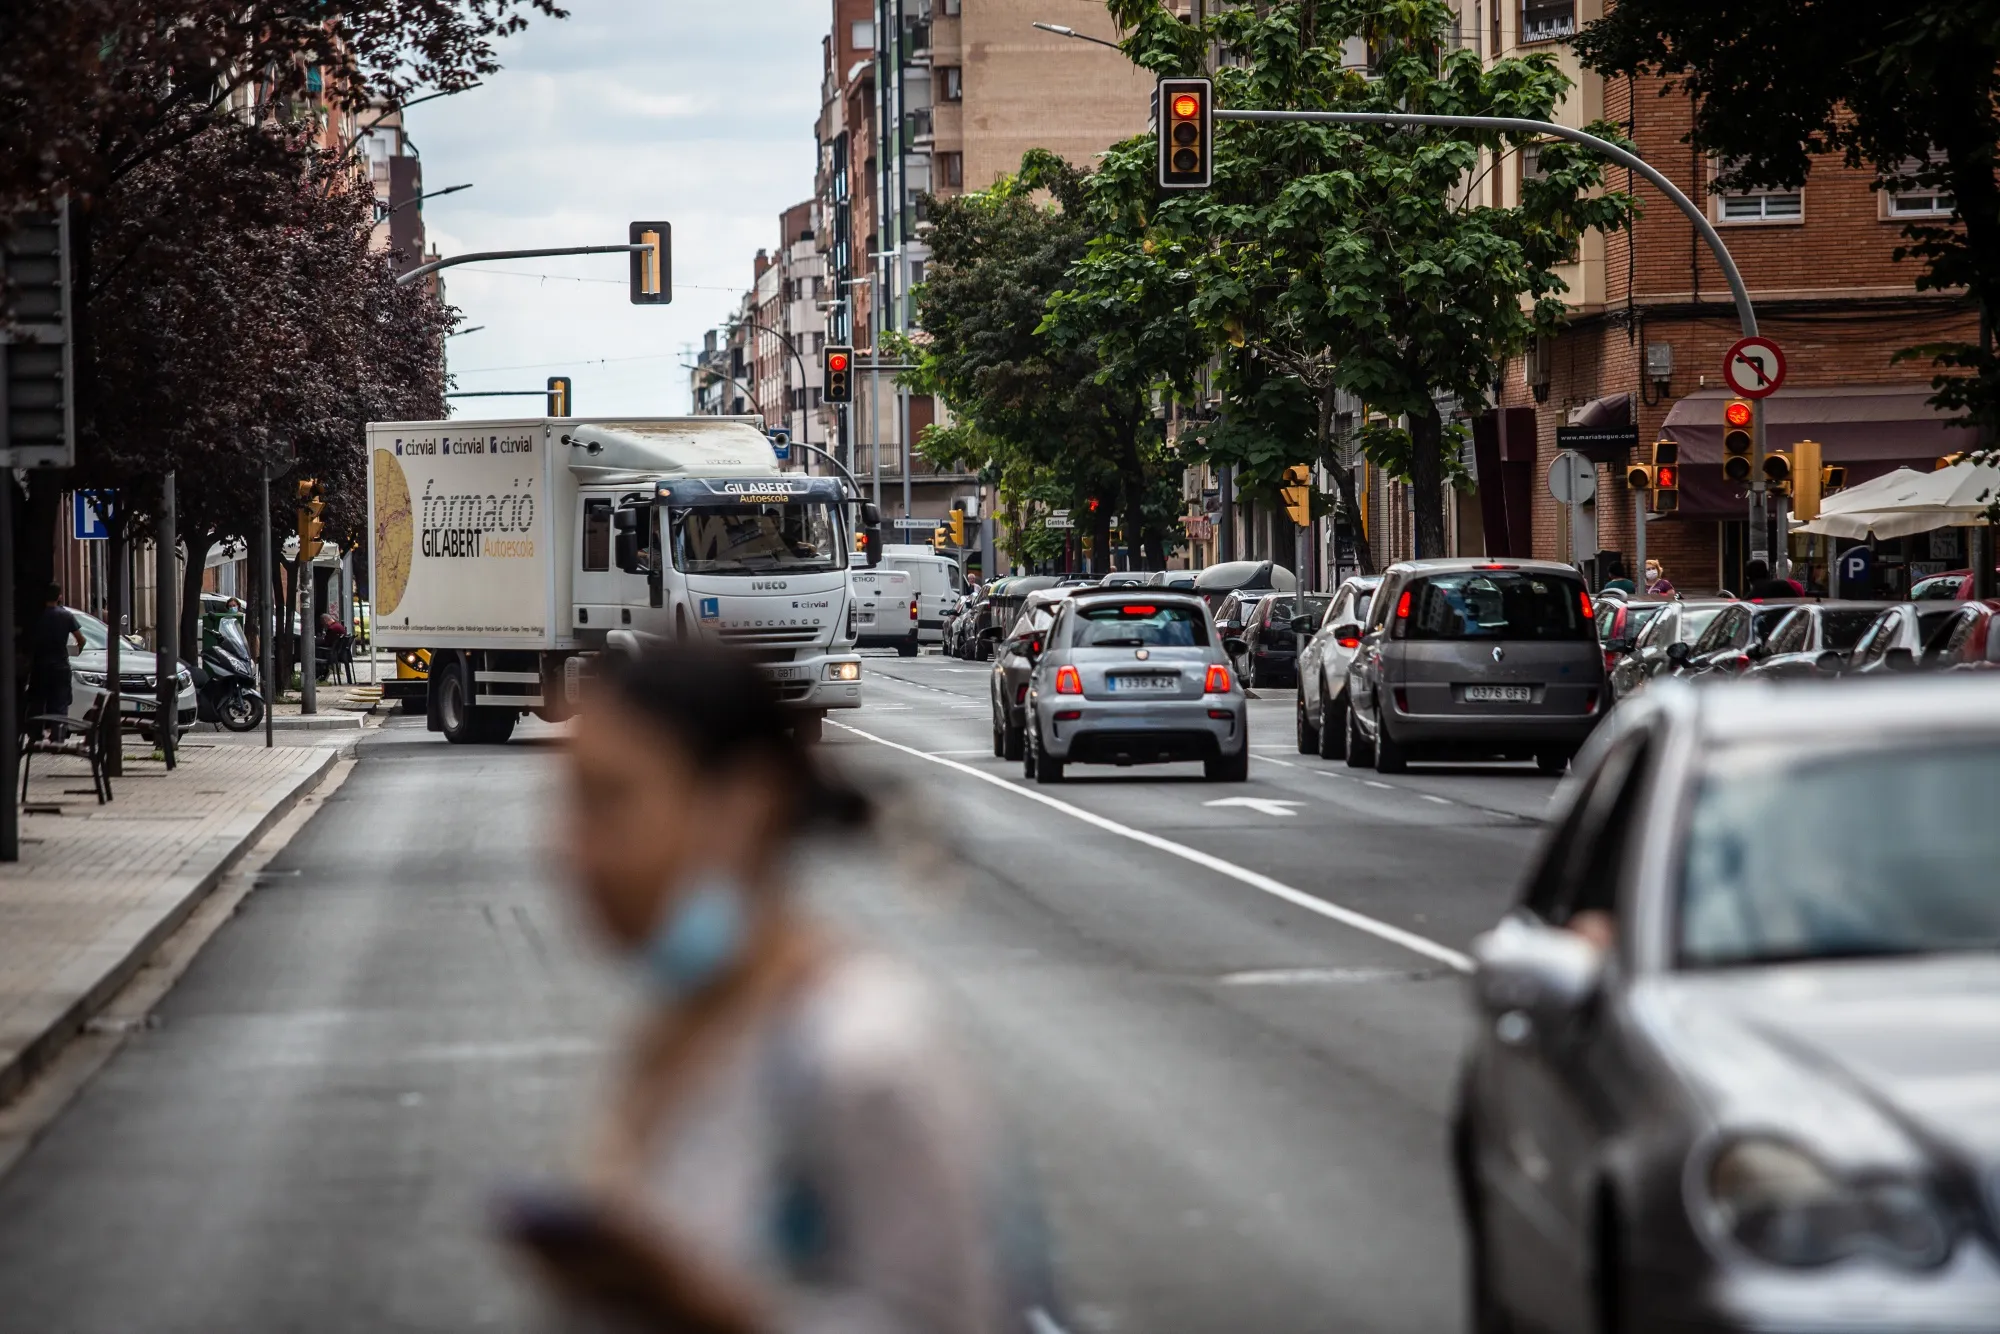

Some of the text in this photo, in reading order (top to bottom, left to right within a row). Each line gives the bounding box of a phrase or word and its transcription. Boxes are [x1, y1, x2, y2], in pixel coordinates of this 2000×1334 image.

[405, 435, 533, 456] cirvial cirvial cirvial
[724, 482, 793, 494] GILABERT
[739, 493, 789, 503] Autoescola
[421, 478, 534, 533] formació
[421, 529, 534, 557] GILABERT Autoescola
[1848, 557, 1865, 578] P
[751, 581, 787, 591] IVECO
[704, 601, 714, 616] L
[800, 601, 829, 609] cirvial
[720, 618, 820, 628] EUROCARGO
[778, 668, 794, 678] GBT
[1118, 677, 1174, 688] 1336 KZR
[1472, 687, 1502, 698] 0376
